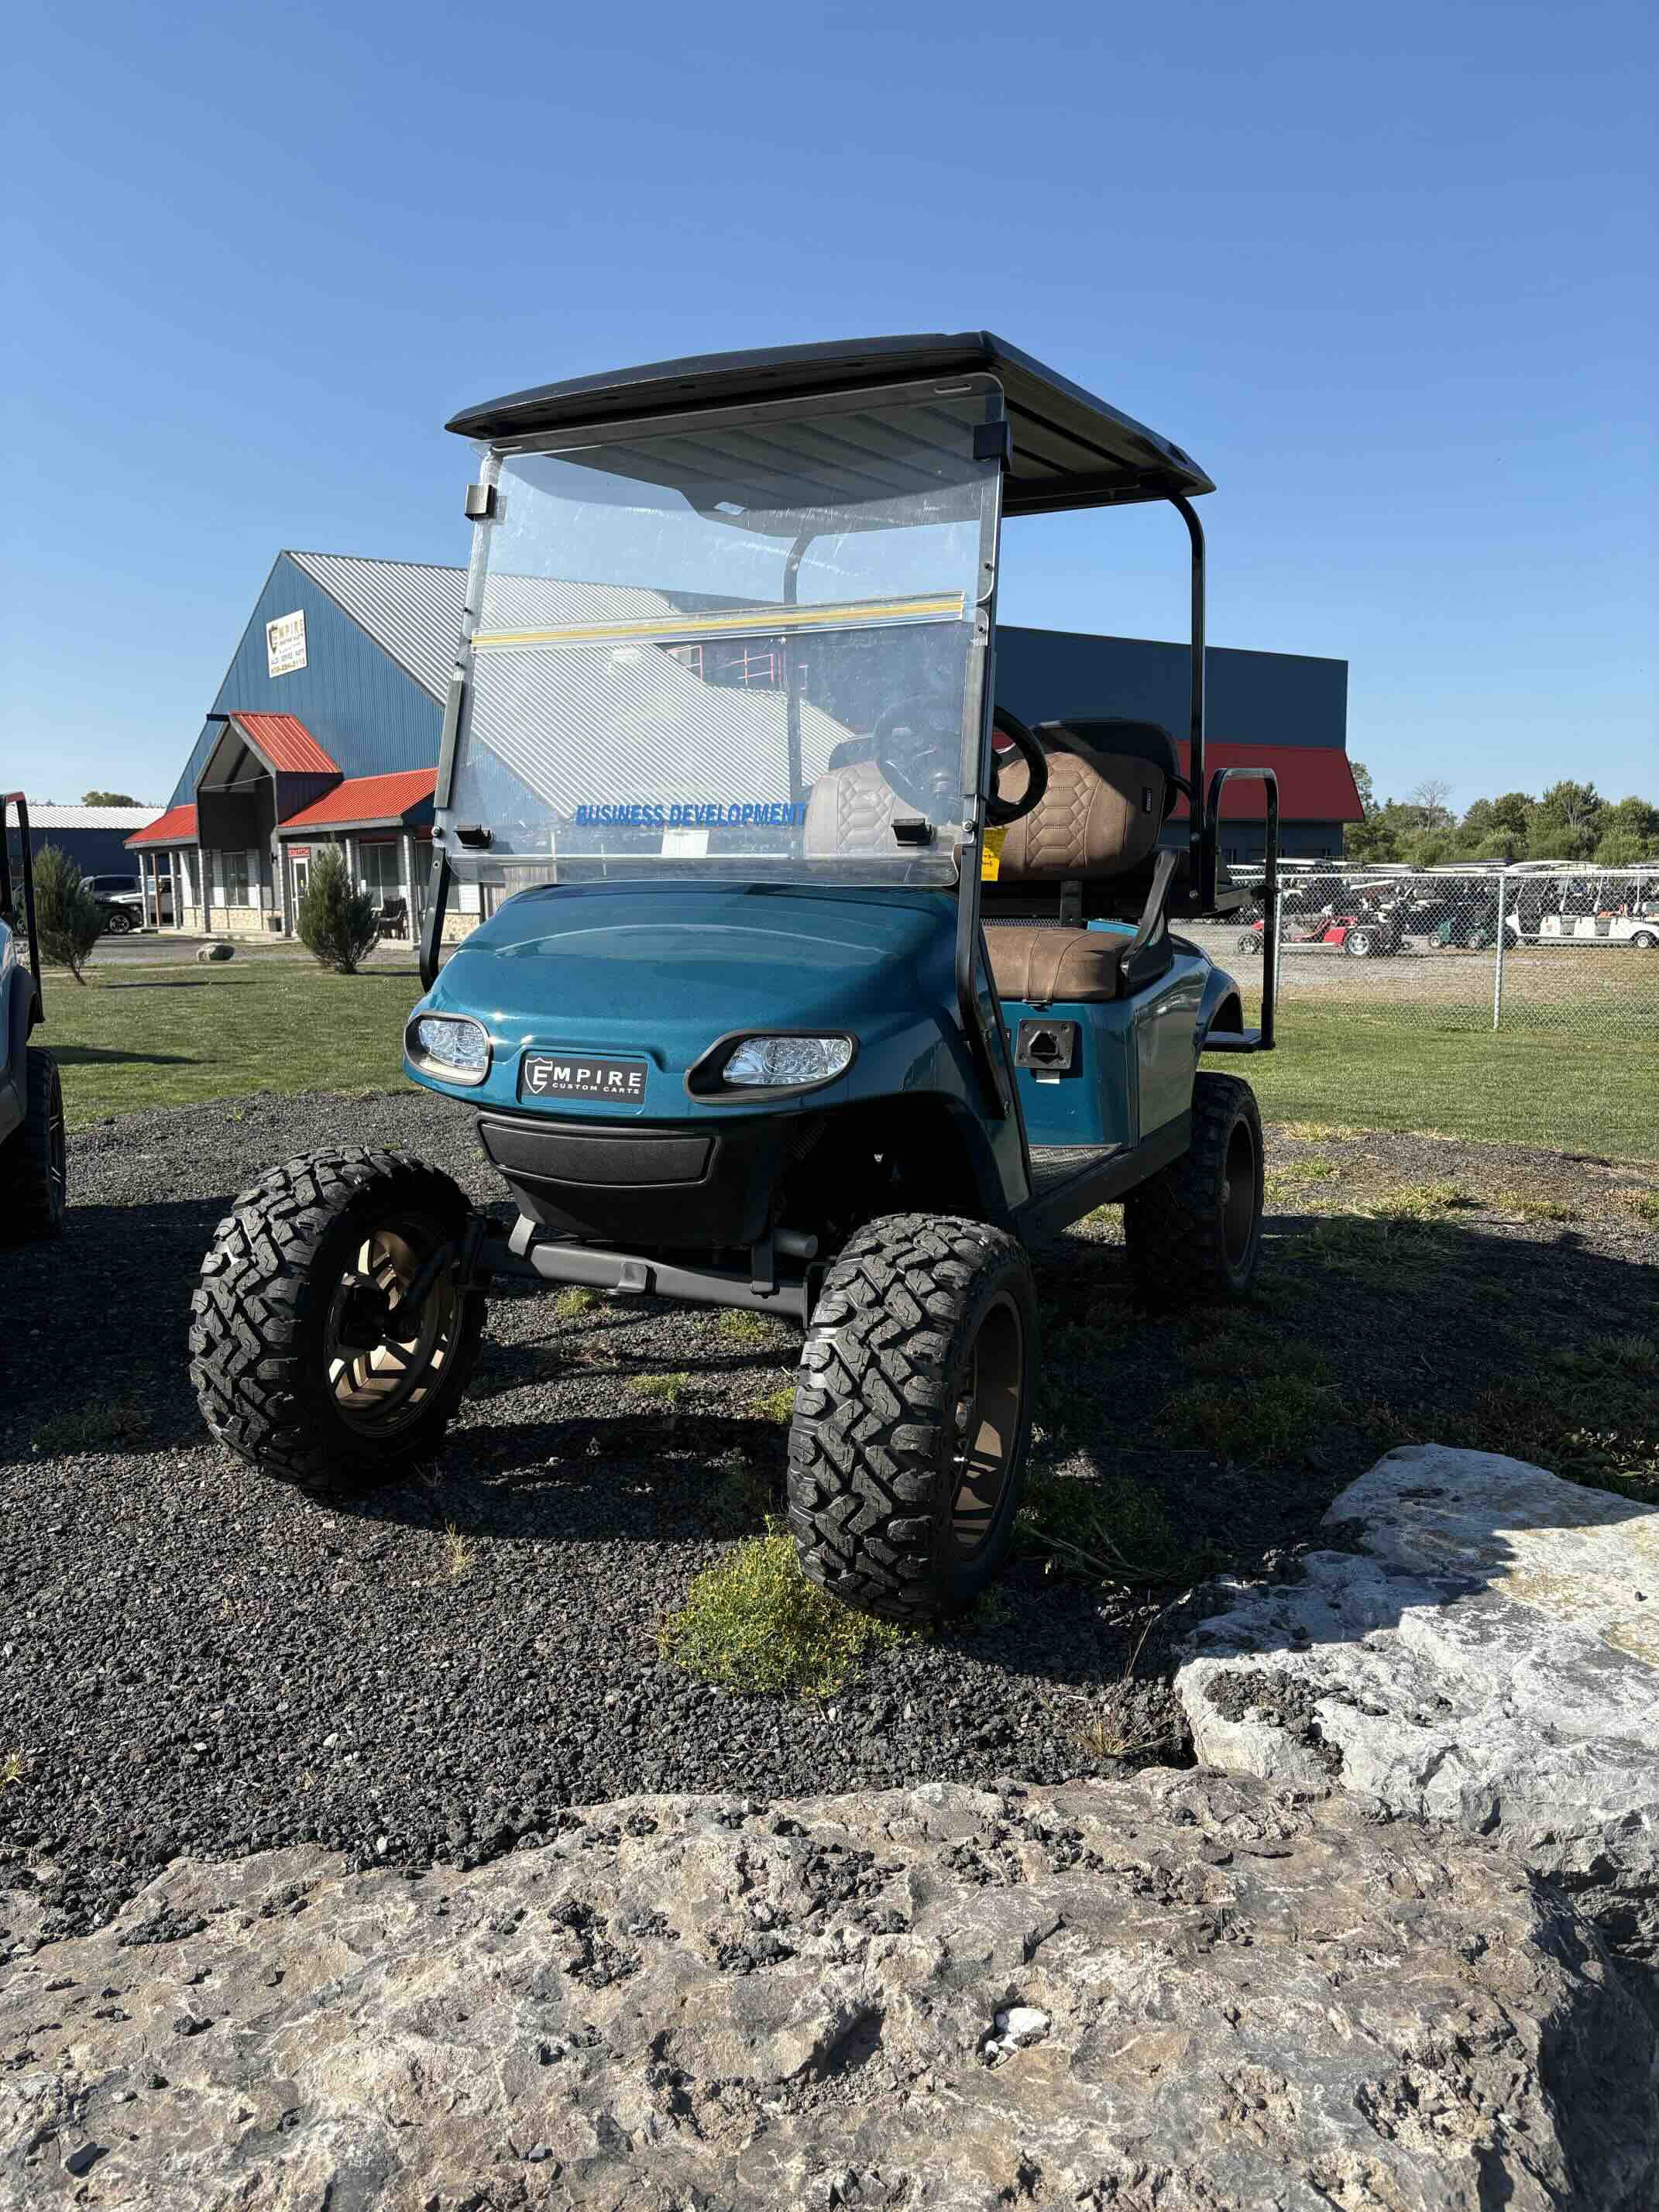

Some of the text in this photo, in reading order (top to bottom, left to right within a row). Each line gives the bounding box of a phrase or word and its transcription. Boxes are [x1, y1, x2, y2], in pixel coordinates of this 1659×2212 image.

[575, 801, 807, 826] BUSINESS DEVELOPMENT
[532, 1065, 642, 1087] EMPIRE
[603, 1086, 639, 1094] CARTS
